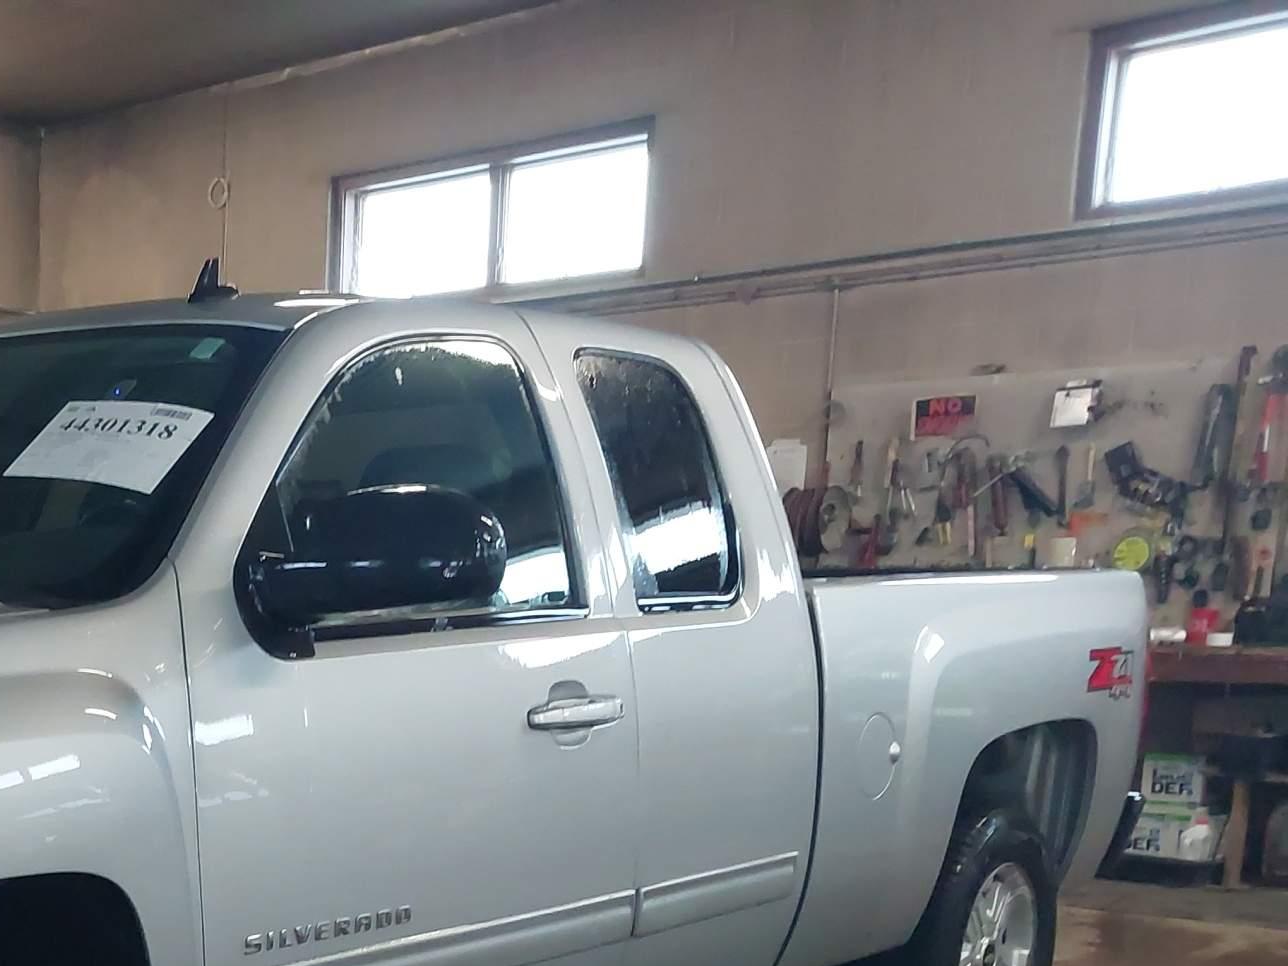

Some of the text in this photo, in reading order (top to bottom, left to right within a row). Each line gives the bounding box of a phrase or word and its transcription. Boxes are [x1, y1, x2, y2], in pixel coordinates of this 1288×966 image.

[928, 397, 963, 416] NO
[60, 417, 178, 440] 44301318
[244, 904, 412, 956] SILVERADO
